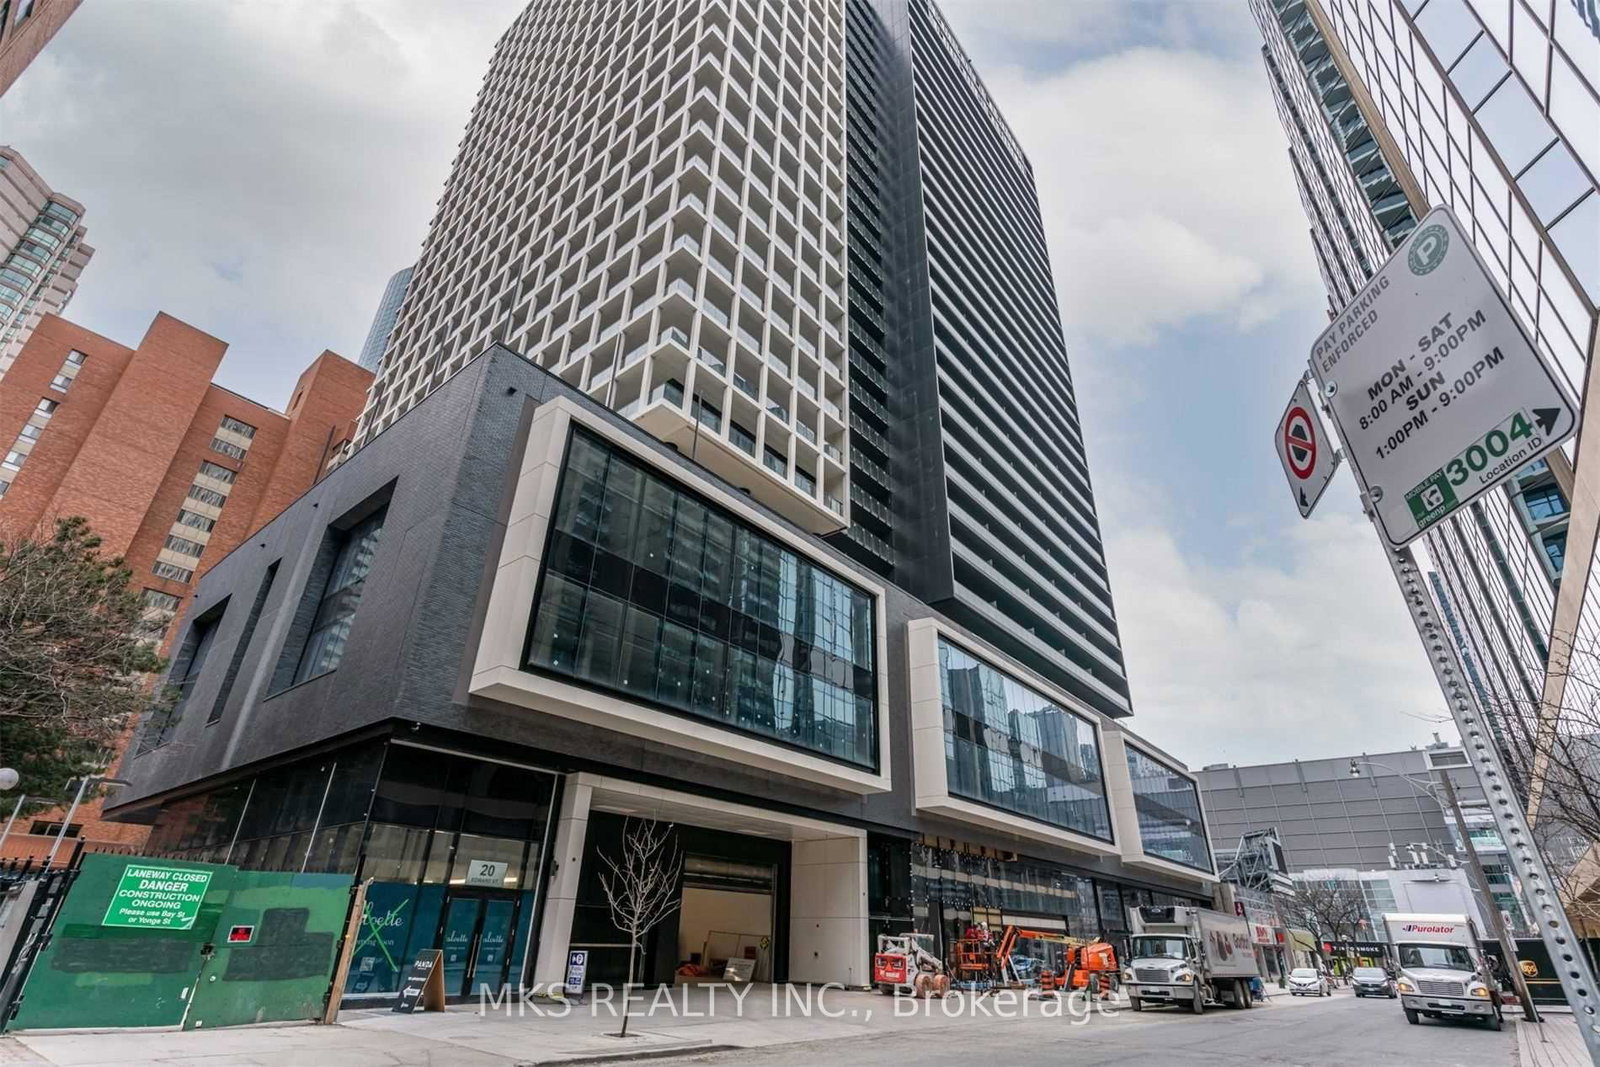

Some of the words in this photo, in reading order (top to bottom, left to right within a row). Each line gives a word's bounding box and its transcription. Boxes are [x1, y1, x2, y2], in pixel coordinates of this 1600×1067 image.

[1316, 333, 1337, 359] PAY
[1338, 275, 1390, 335] PARKING
[1321, 309, 1378, 373] ENFORCED
[1359, 399, 1388, 430] 8:00
[1391, 375, 1414, 404] AM
[1424, 309, 1487, 371] 9:00PM
[1367, 360, 1407, 400] MON
[1418, 313, 1454, 352] SAT
[1376, 410, 1429, 460] 1:00PM
[1439, 347, 1505, 407] 9:00PM
[1406, 371, 1446, 411] SUN
[1446, 412, 1534, 486] 3004
[1479, 448, 1527, 484] Location
[1527, 437, 1542, 451] ID
[127, 869, 172, 880] LANEWAY
[172, 873, 207, 883] CLOSED
[480, 864, 495, 877] 20
[119, 890, 200, 902] CONSTRUCTION
[139, 880, 188, 892] DANGER
[119, 908, 145, 916] Please
[132, 900, 181, 909] ONGOING
[139, 917, 161, 925] Yonge
[1411, 925, 1454, 934] Purolator
